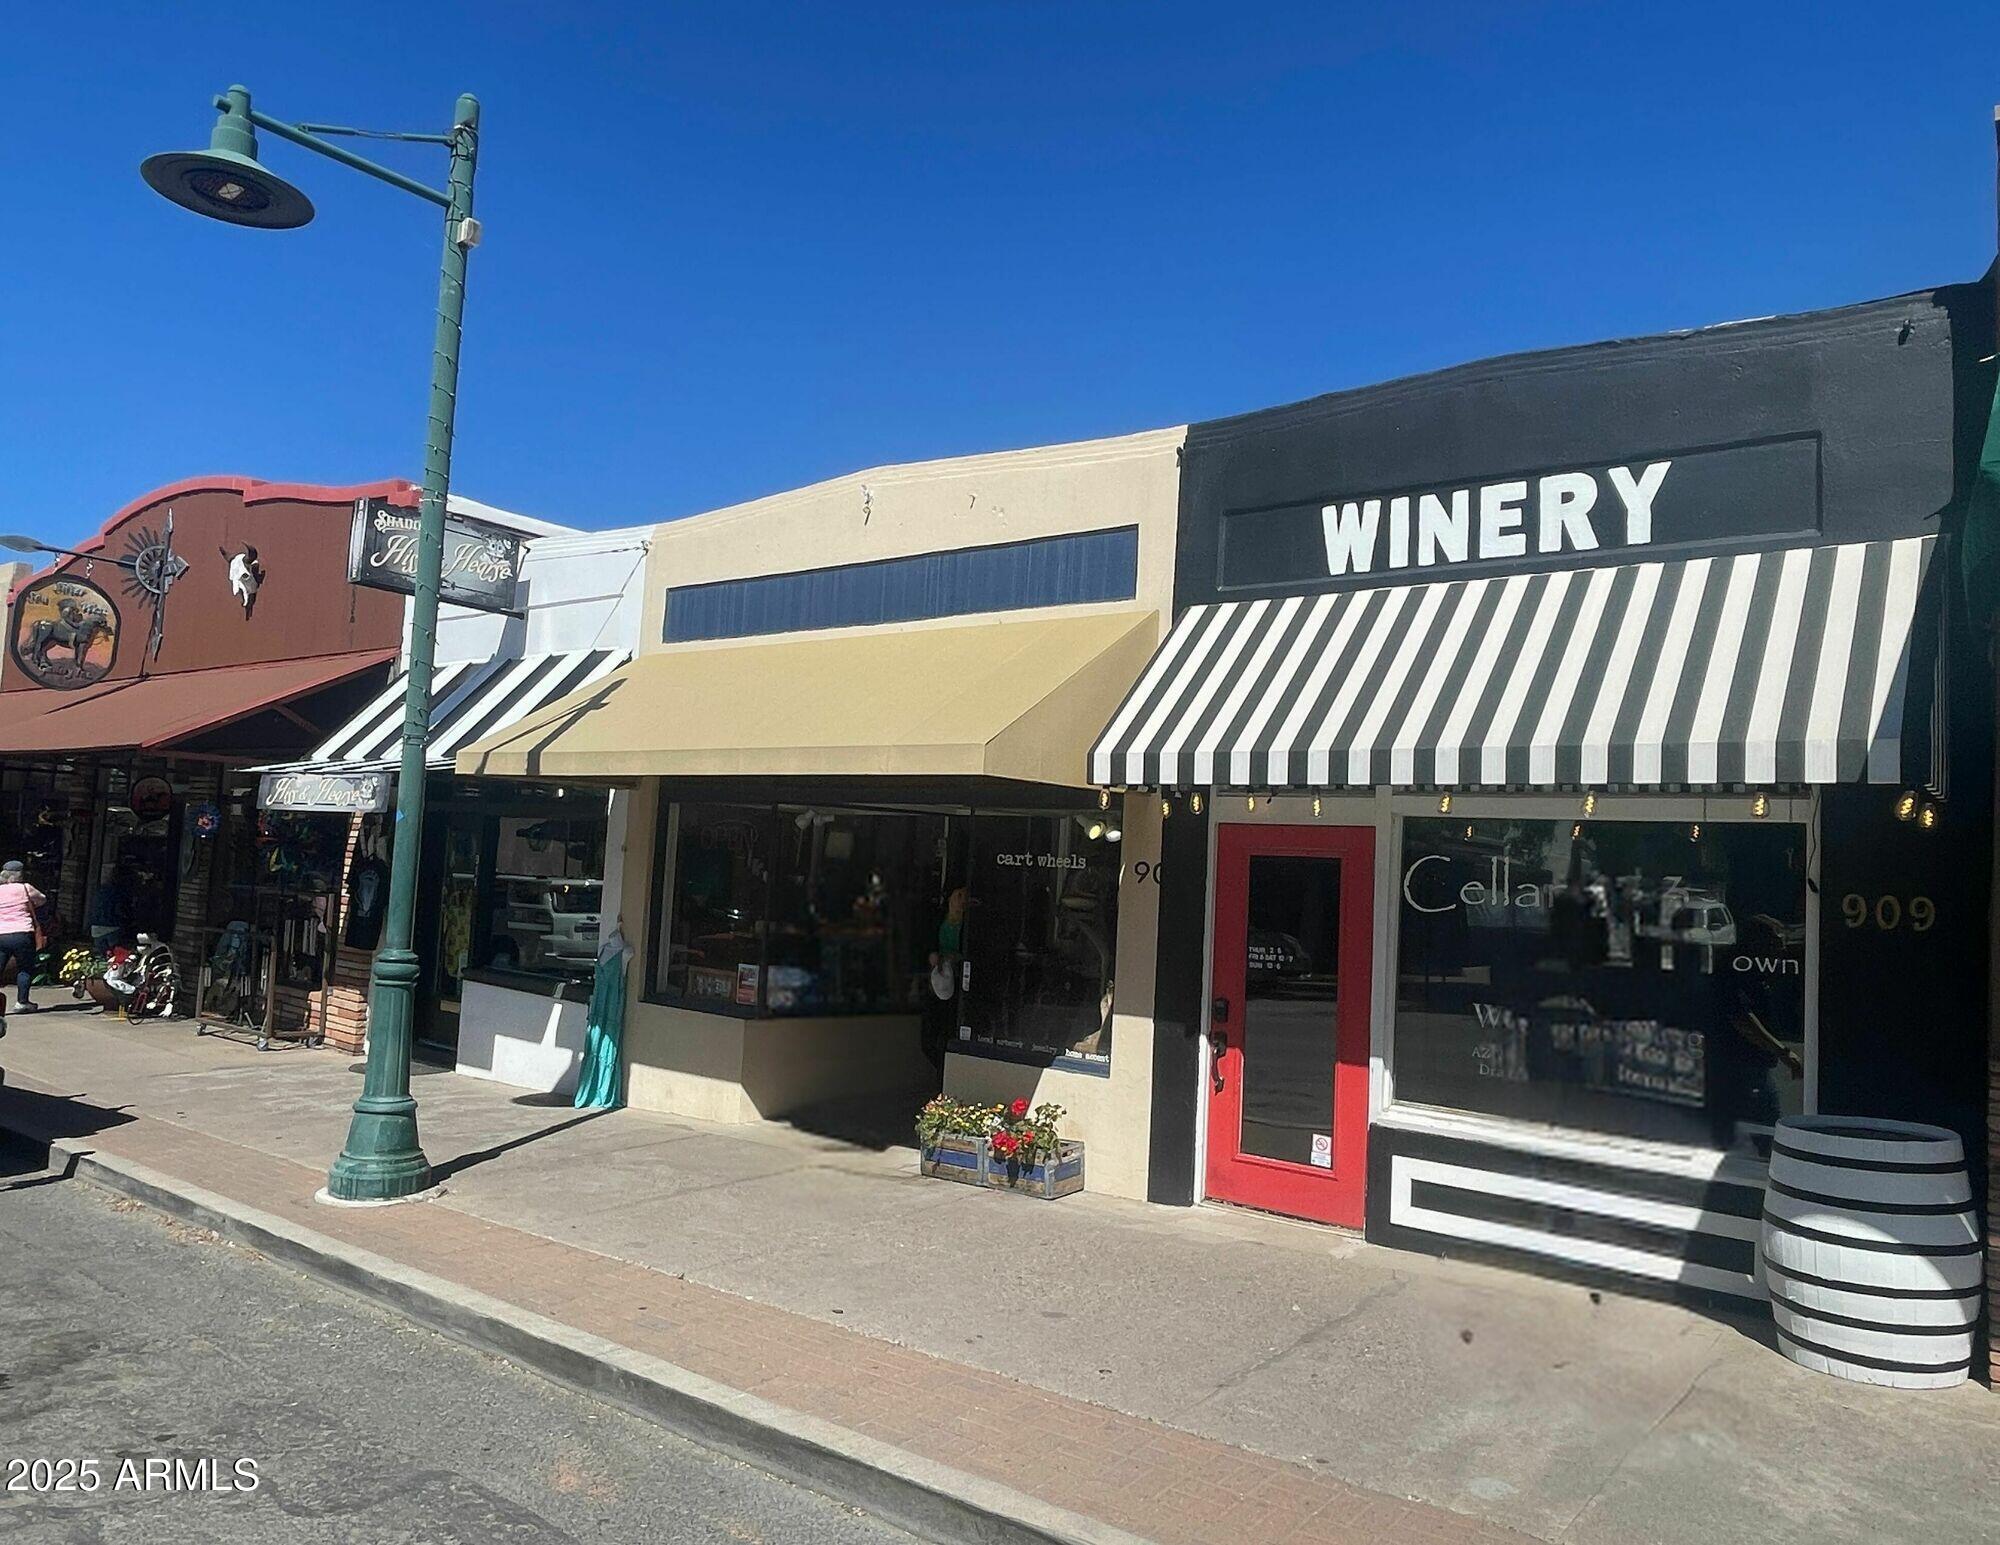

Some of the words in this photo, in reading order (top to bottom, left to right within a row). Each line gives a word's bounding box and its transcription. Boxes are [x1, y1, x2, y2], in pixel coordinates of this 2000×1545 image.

[1322, 461, 1671, 575] WINERY
[442, 543, 513, 582] Hearse
[996, 852, 1033, 866] cart
[1037, 853, 1087, 869] wheels
[1841, 893, 1937, 932] 909
